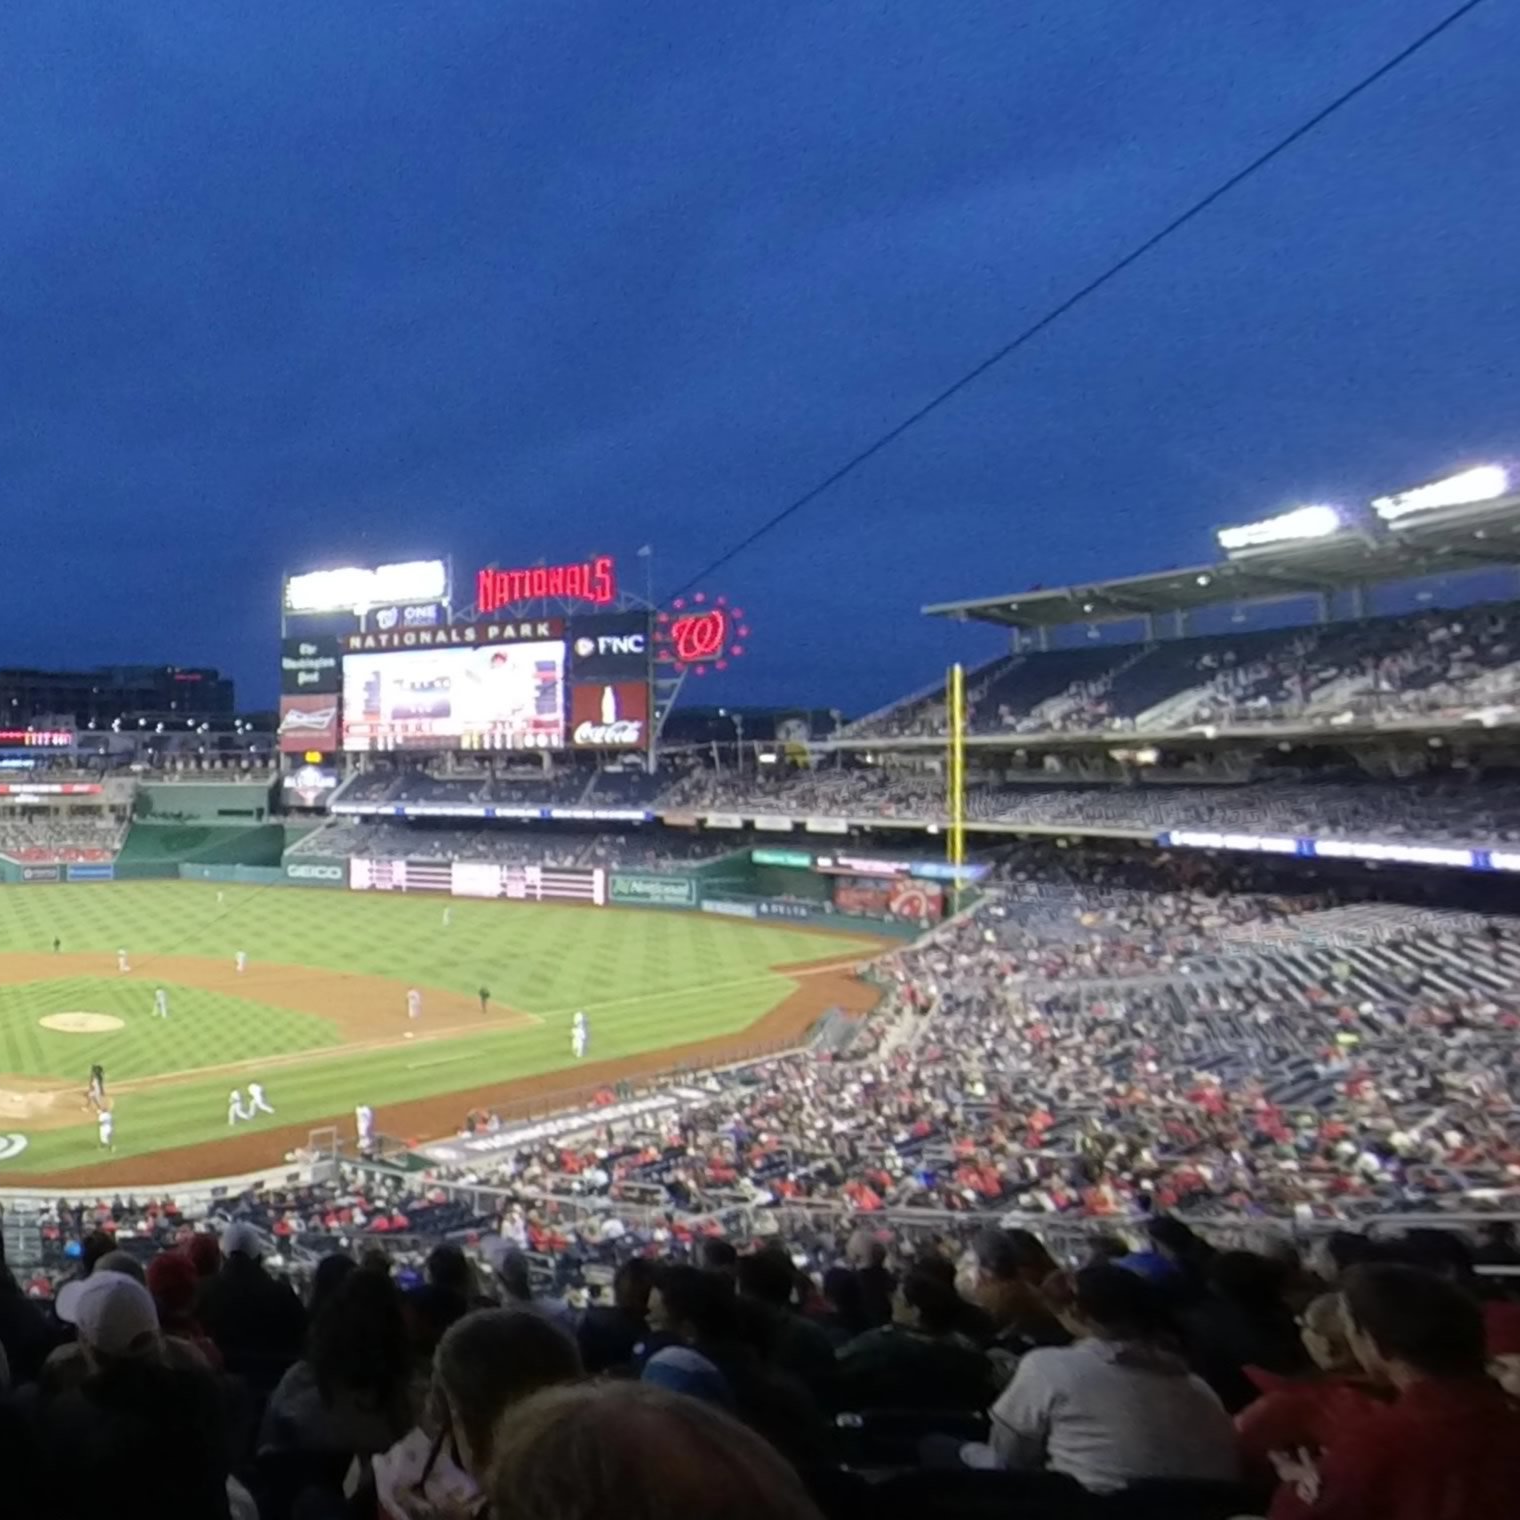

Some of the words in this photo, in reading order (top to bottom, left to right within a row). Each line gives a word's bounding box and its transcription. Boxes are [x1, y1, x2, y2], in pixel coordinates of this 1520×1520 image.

[477, 556, 613, 613] NATIONALS
[404, 604, 436, 620] ONE
[349, 628, 477, 649] NATIONALS
[488, 622, 550, 640] PARK
[671, 609, 725, 661] W
[287, 864, 342, 879] GEICO
